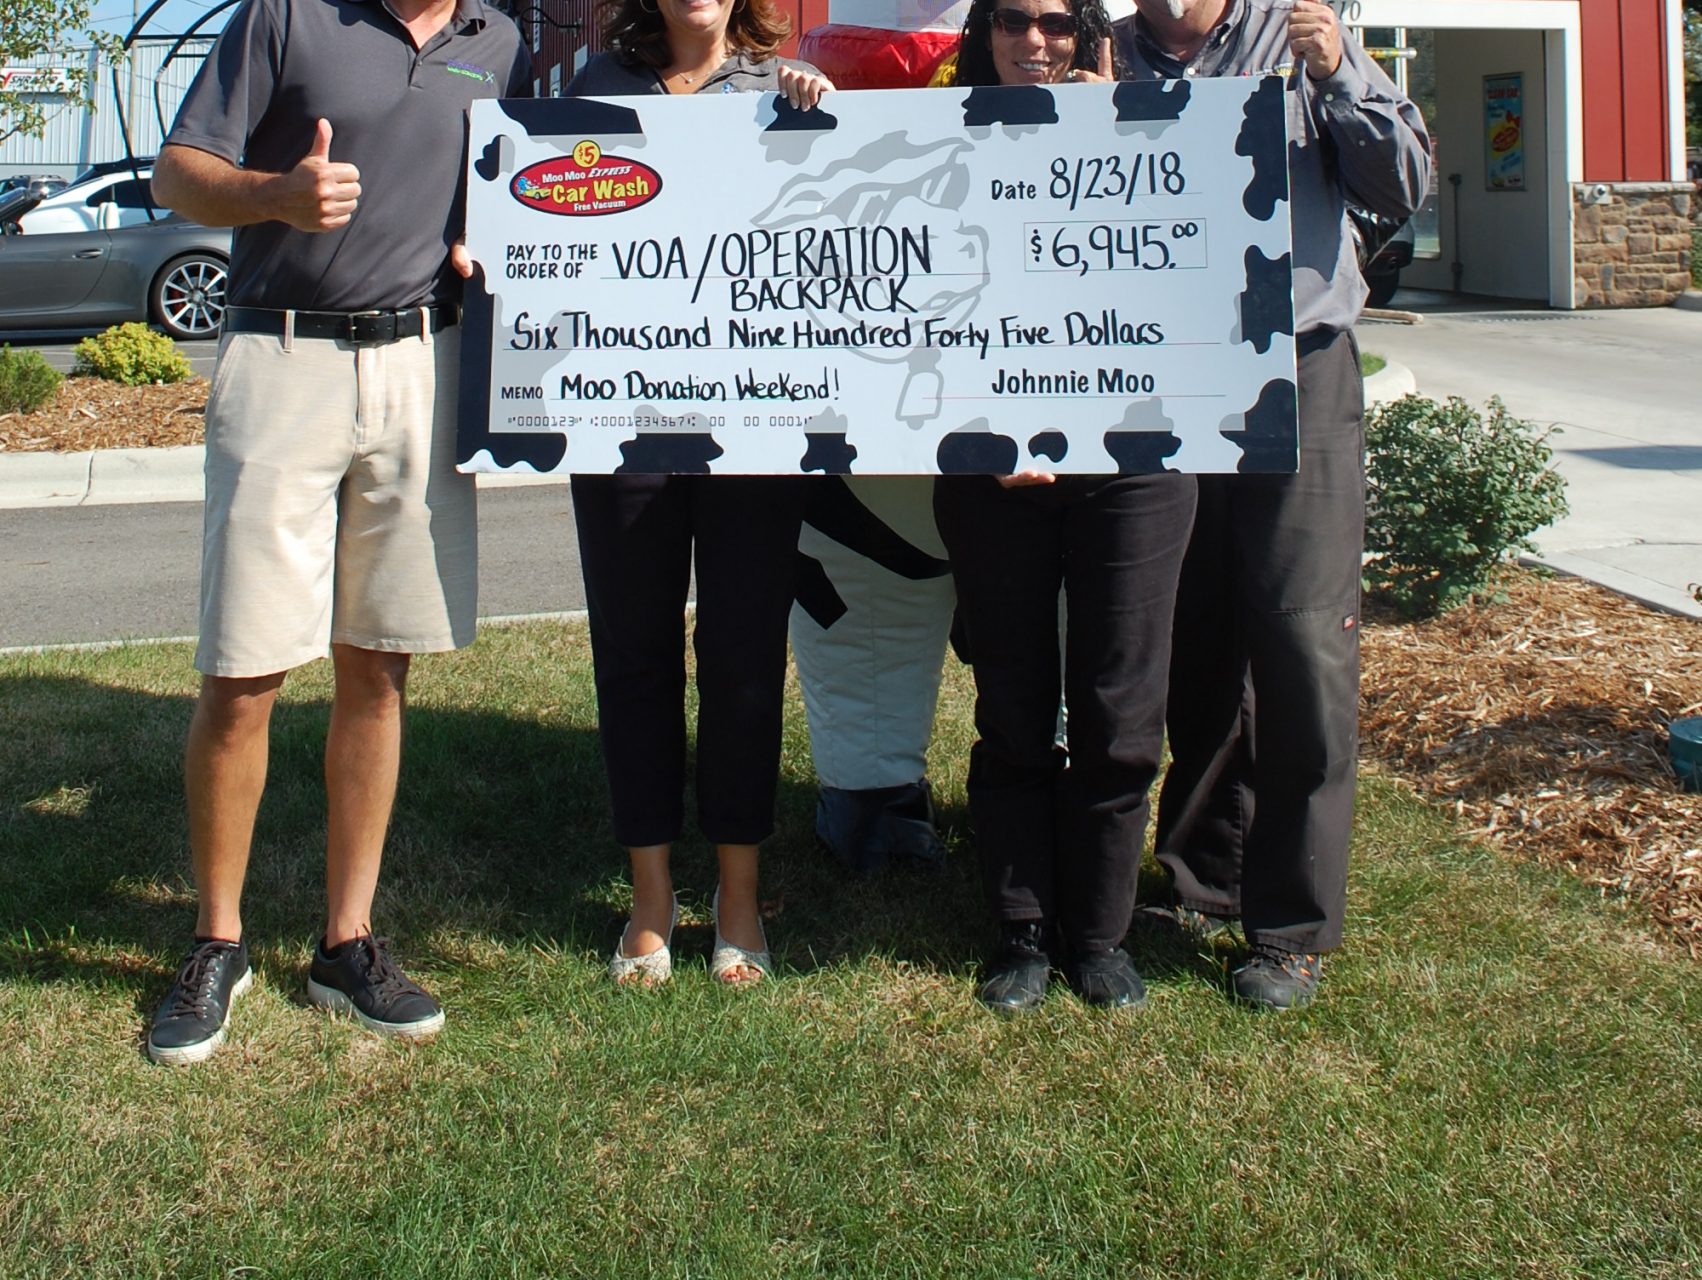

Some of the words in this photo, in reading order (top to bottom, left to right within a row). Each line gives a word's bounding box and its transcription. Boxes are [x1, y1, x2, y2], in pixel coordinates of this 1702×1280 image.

[578, 145, 595, 165] $5
[542, 173, 563, 183] Moo
[565, 171, 586, 181] Moo
[991, 180, 1036, 200] Date
[1049, 151, 1186, 211] 8/23/18
[552, 184, 588, 204] Car
[593, 176, 649, 200] Wash
[574, 202, 591, 211] Free
[593, 200, 626, 210] Vacuum
[506, 244, 536, 262] PAY
[542, 244, 562, 261] TO
[567, 243, 598, 260] THE
[506, 263, 560, 279] ORDER
[564, 263, 583, 278] OF
[730, 277, 918, 313] BACKPACK
[510, 312, 557, 351] Six
[562, 310, 712, 350] Thousand
[729, 318, 787, 348] Nine
[793, 317, 912, 349] Hundred
[924, 317, 990, 360] Forty
[1000, 315, 1055, 349] Five
[1064, 309, 1165, 347] Dollars
[501, 386, 543, 400] MEMO
[561, 374, 616, 401] Moo
[624, 370, 726, 402] Donation
[991, 369, 1089, 395] Johnnie
[1097, 369, 1155, 395] Moo
